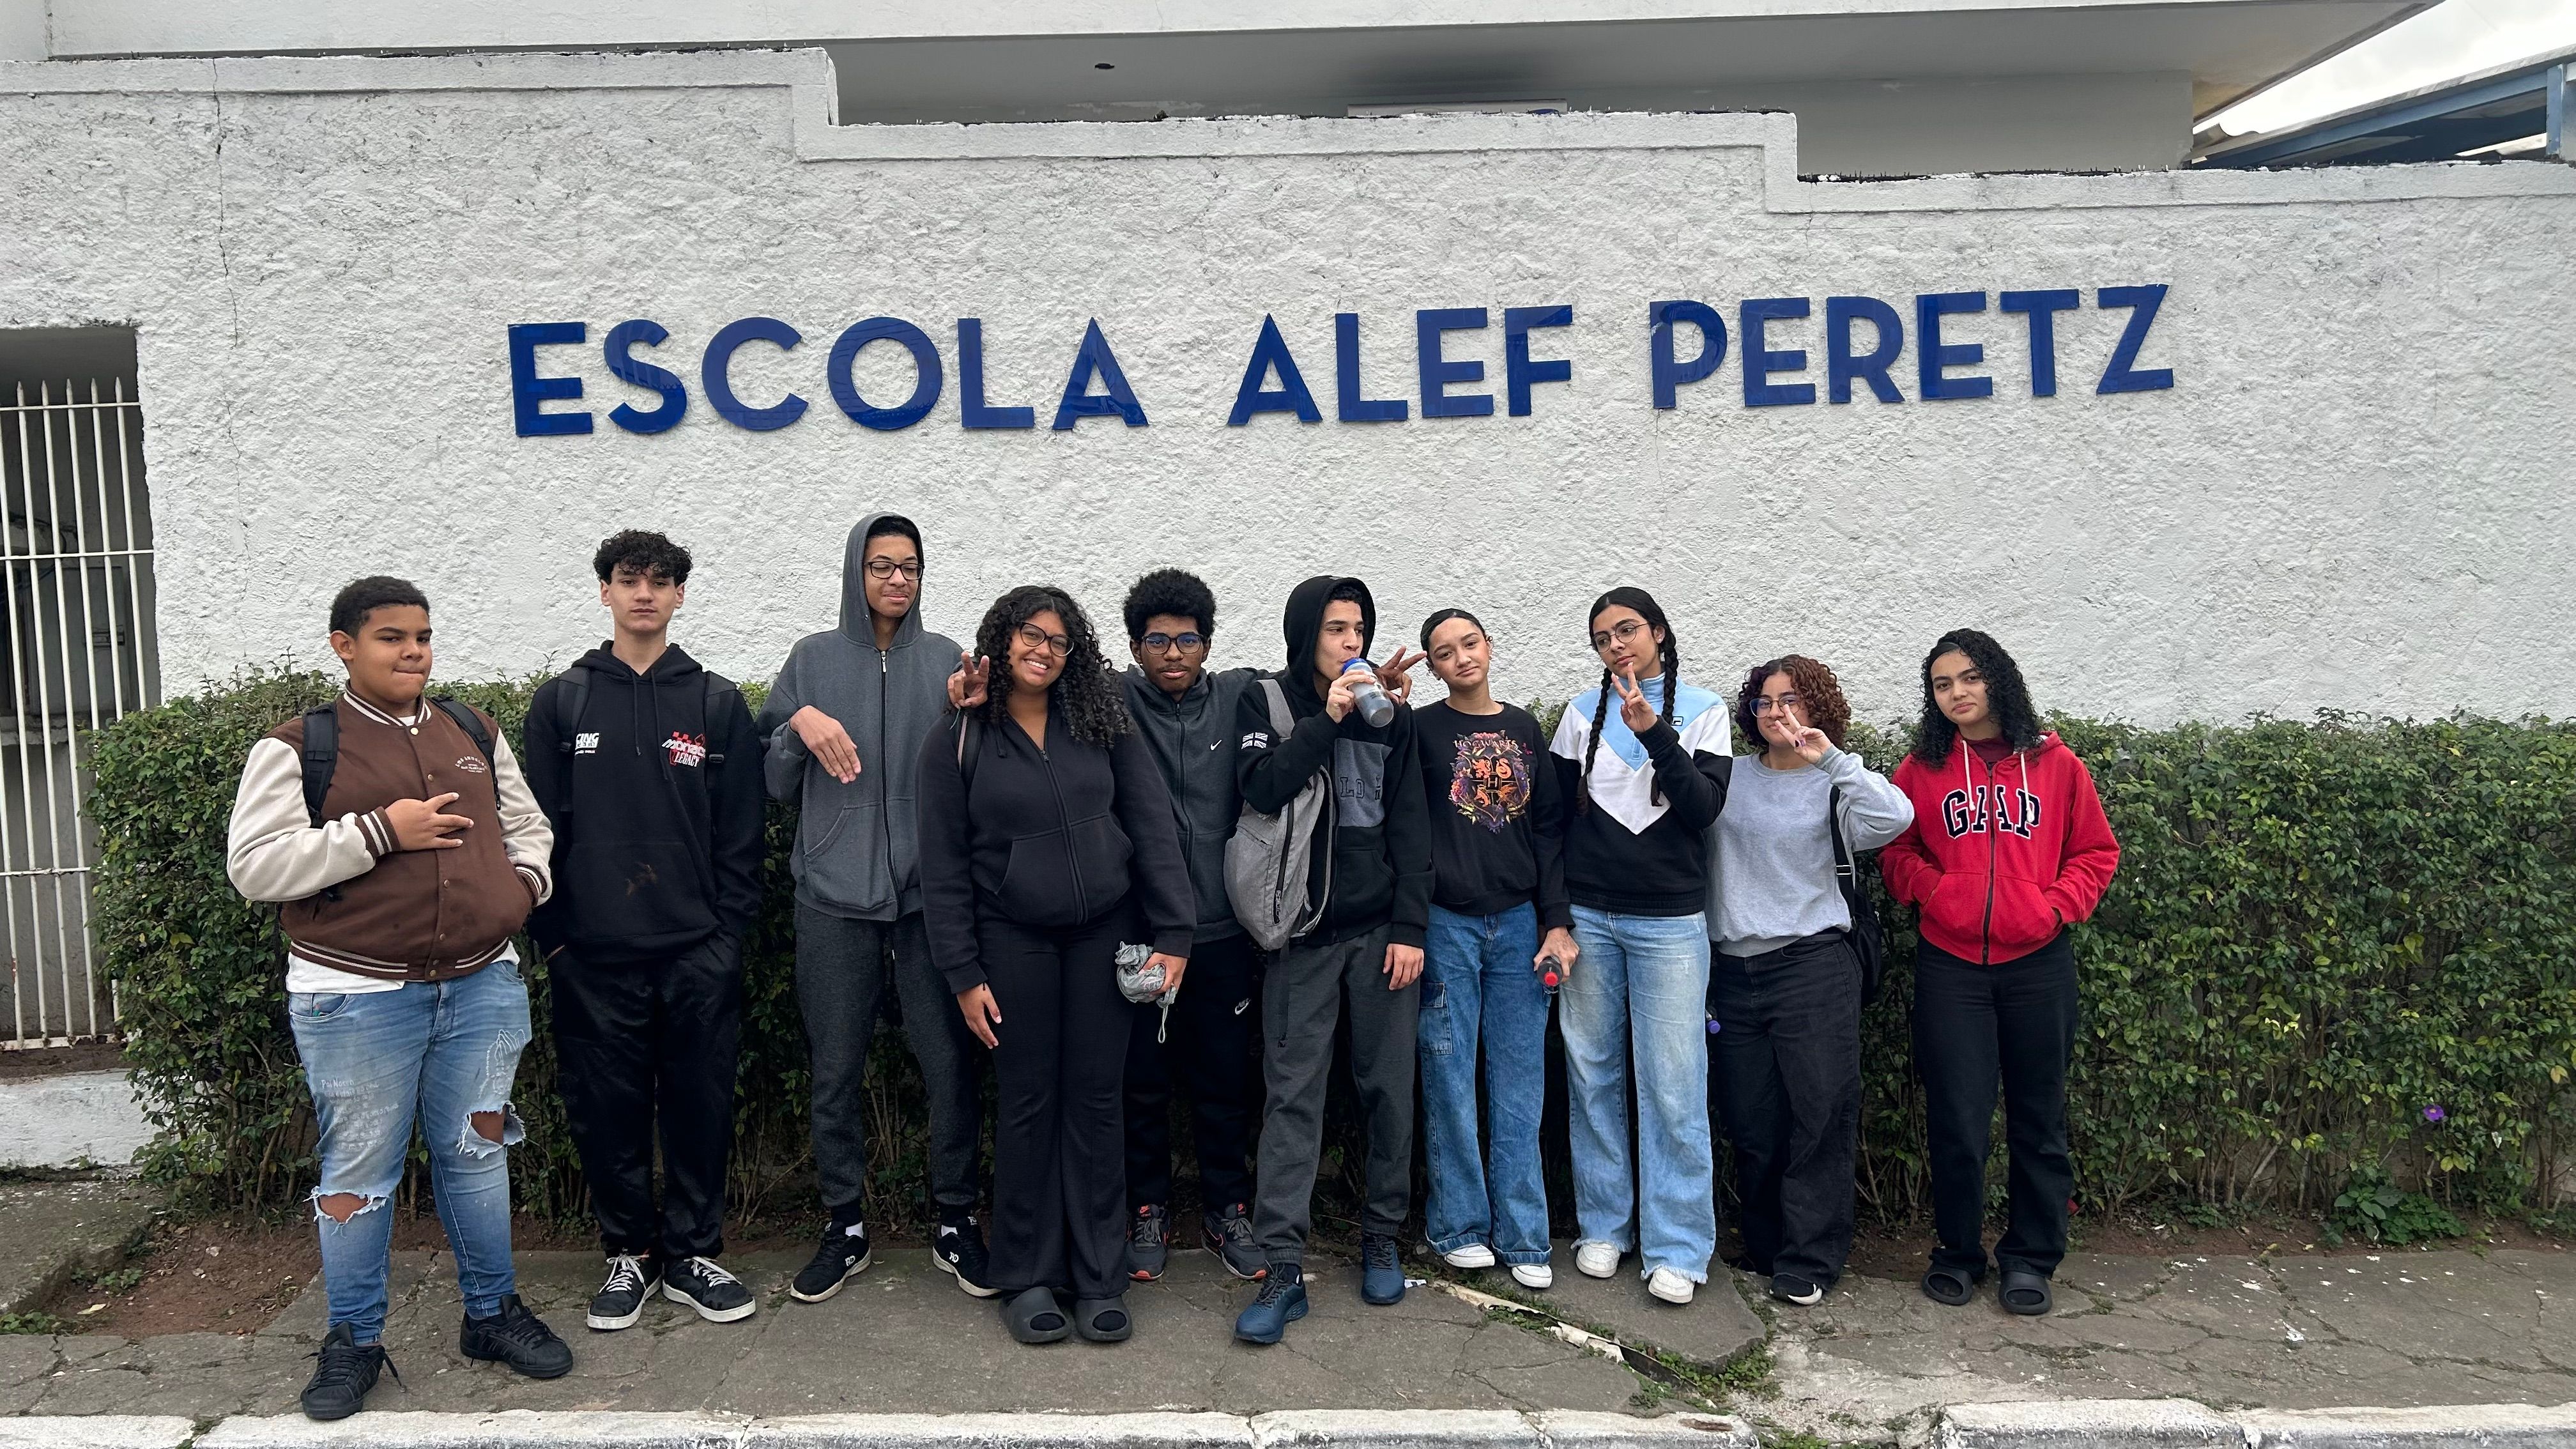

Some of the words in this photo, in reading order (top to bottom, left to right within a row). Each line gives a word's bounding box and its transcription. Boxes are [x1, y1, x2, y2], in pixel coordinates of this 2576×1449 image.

[509, 317, 1147, 436] ESCOLA
[1229, 305, 1573, 425] ALEF
[1650, 285, 2174, 408] PERETZ
[674, 751, 700, 767] LEGACY
[1942, 785, 2042, 840] GAP
